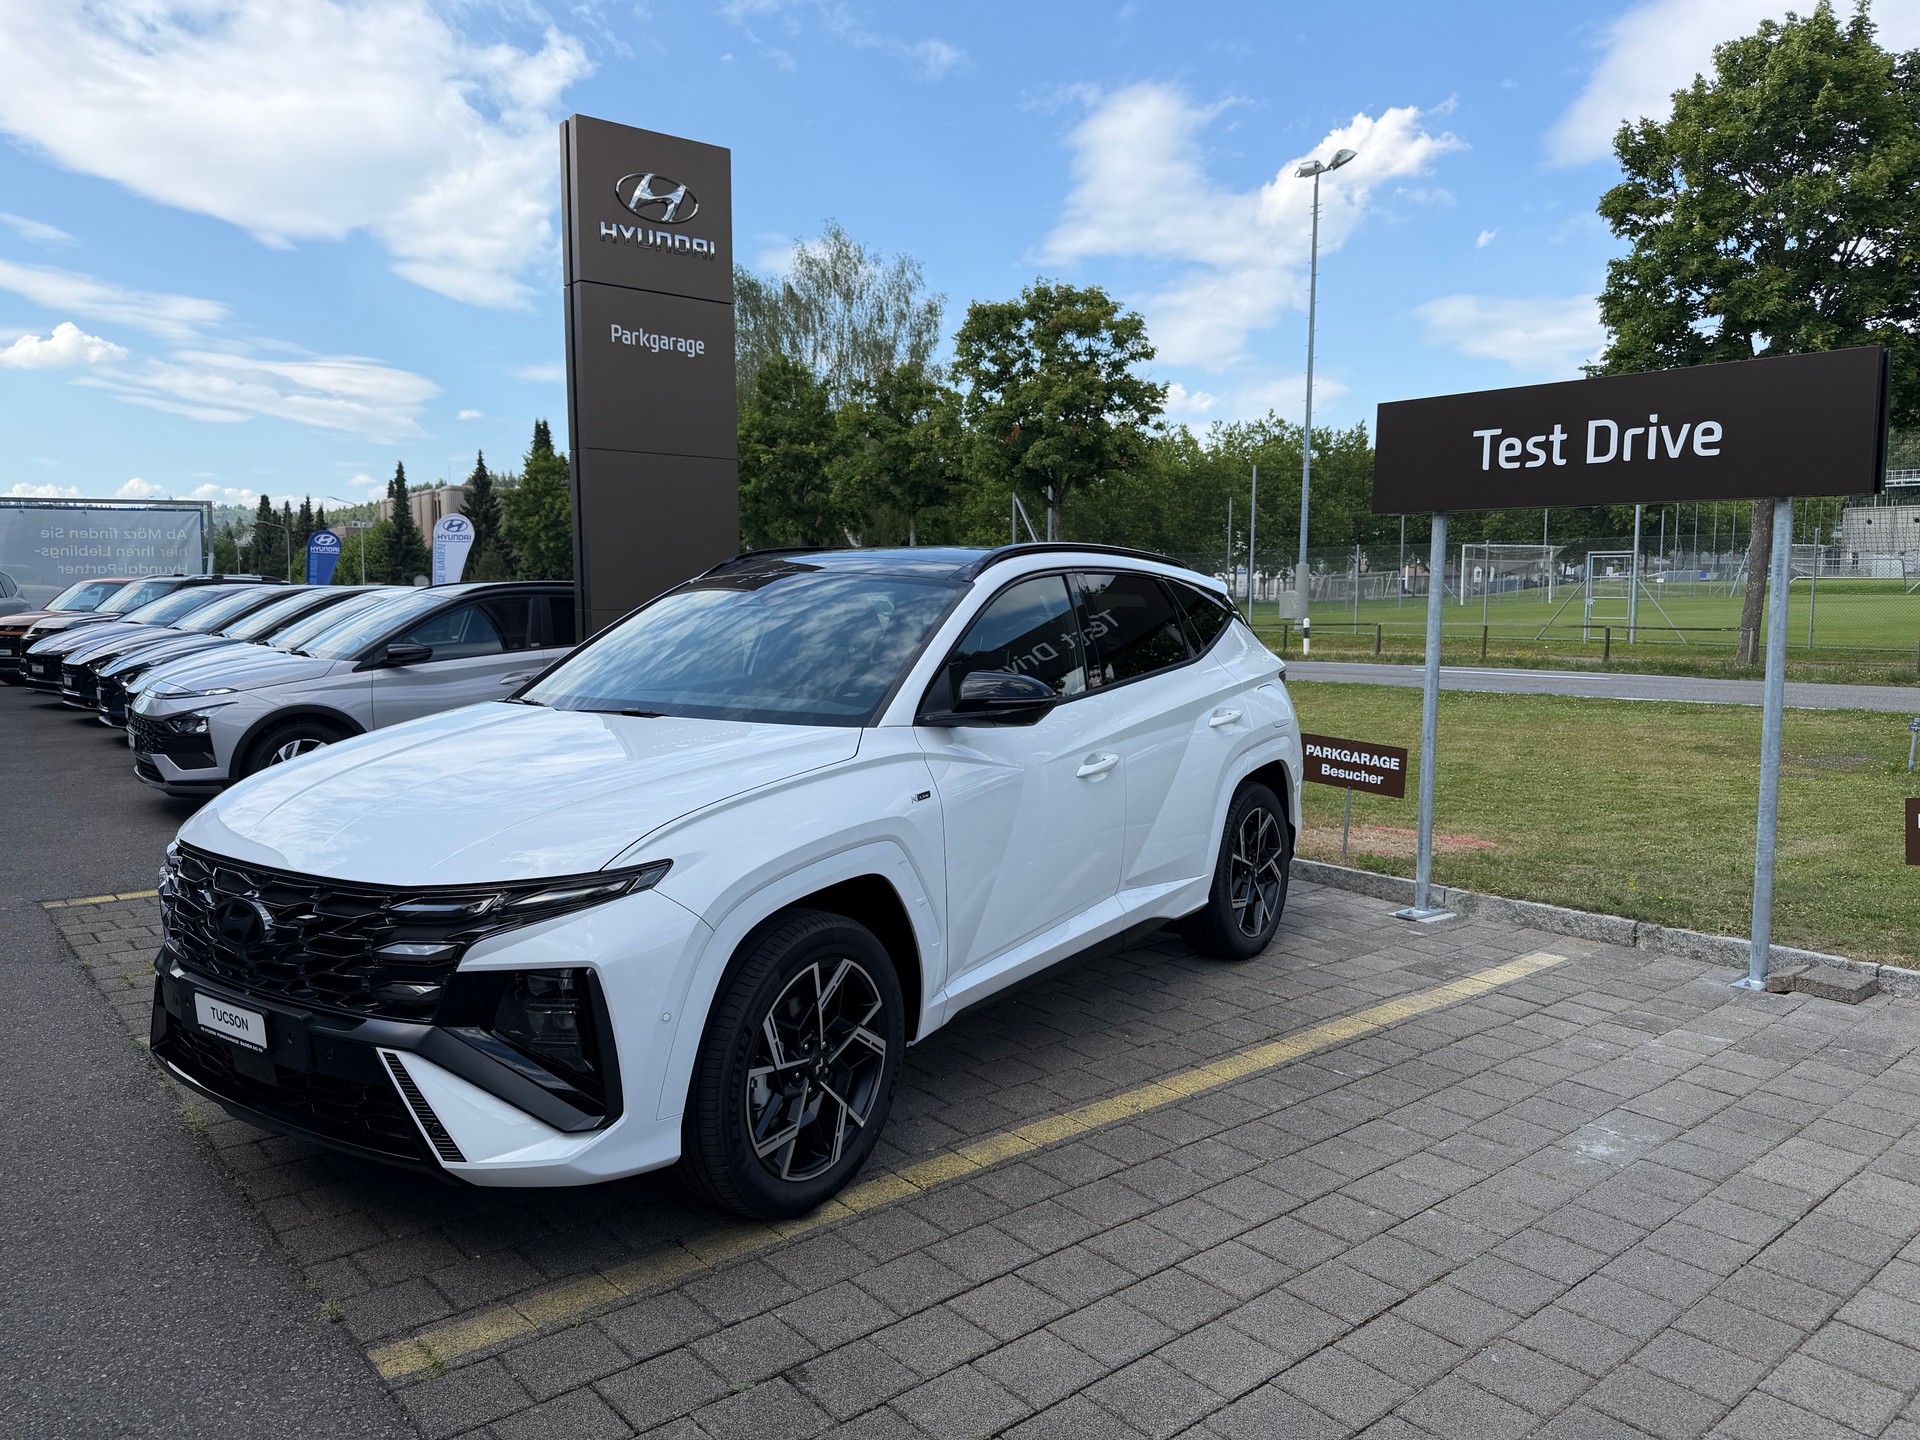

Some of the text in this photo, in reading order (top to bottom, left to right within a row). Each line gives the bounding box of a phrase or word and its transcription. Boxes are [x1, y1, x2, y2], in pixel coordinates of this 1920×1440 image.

[600, 221, 716, 260] HYUNDAI
[610, 324, 705, 357] Parkgarage
[1473, 413, 1723, 471] Test Drive
[437, 543, 446, 571] BADEN
[1305, 744, 1400, 770] PARKGARAGE
[1321, 763, 1384, 785] Besucher
[210, 1006, 249, 1031] TUCSON
